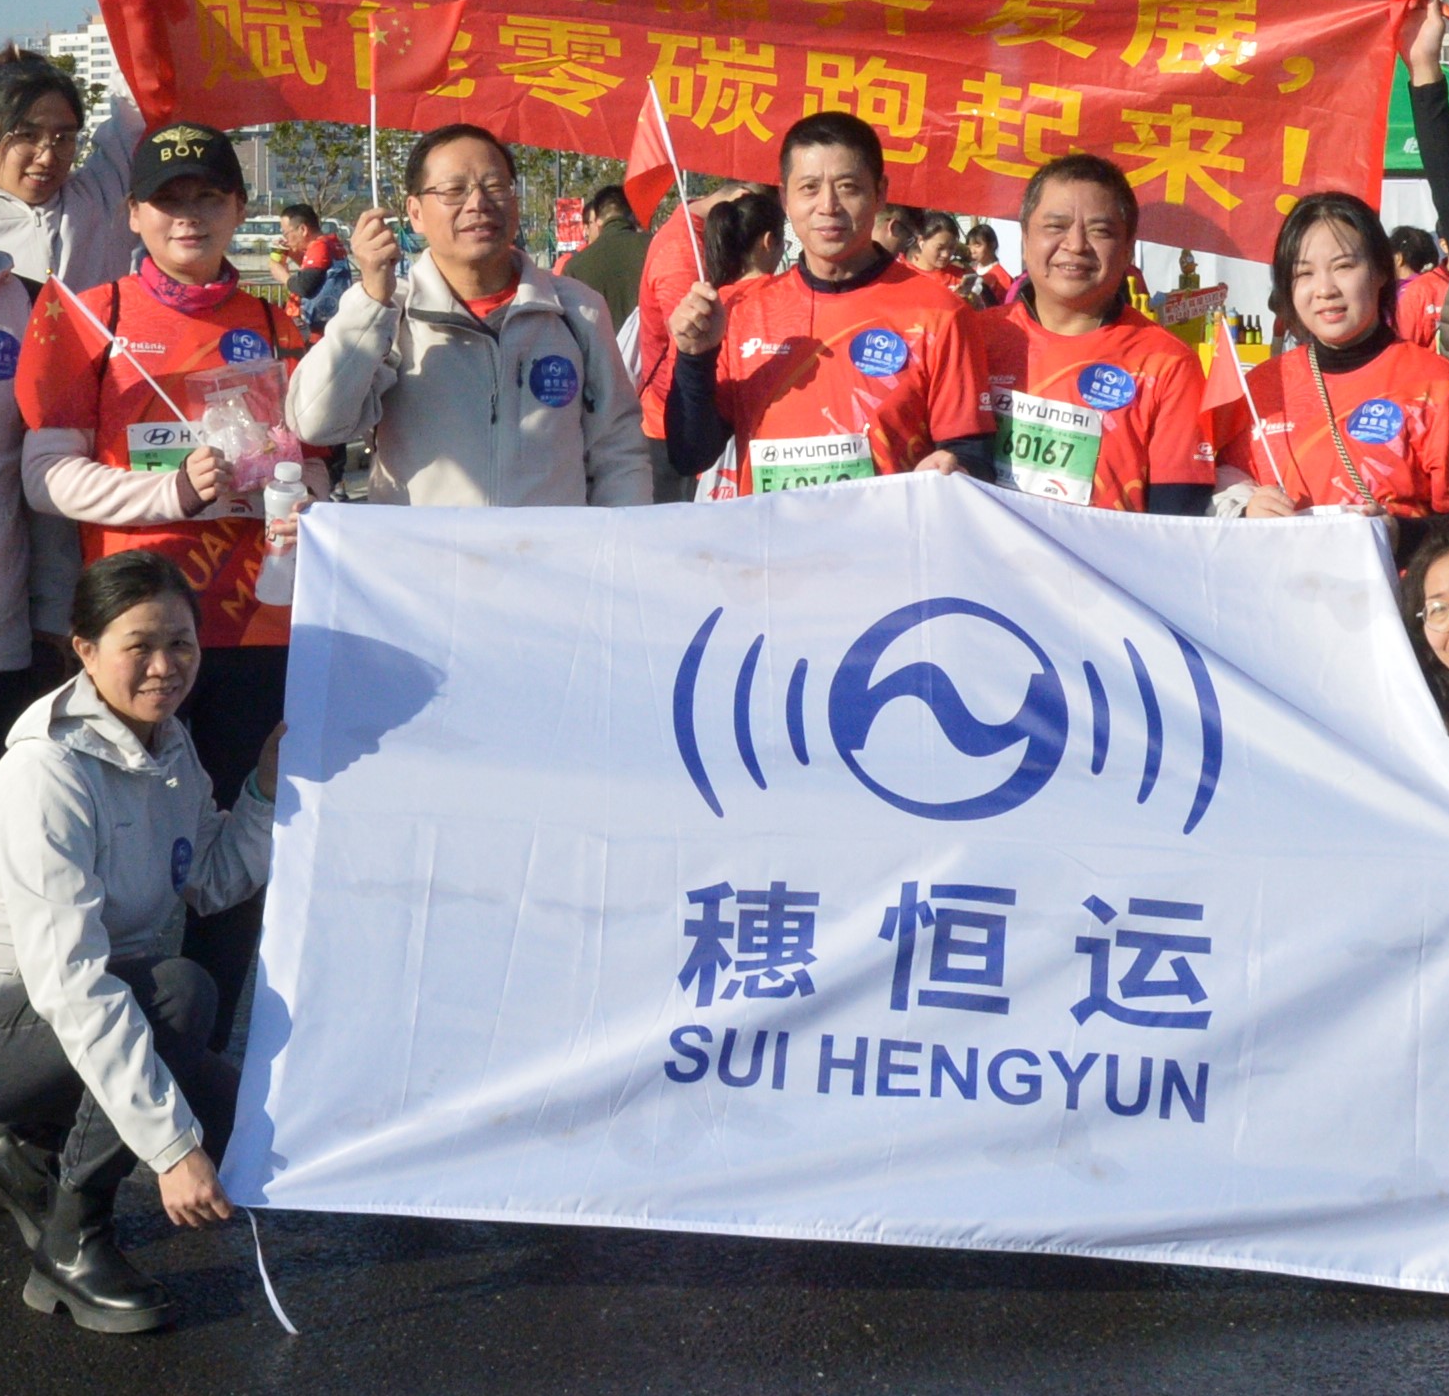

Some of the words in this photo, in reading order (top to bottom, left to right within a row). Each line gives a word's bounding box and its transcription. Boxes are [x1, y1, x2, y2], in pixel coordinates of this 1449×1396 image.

[160, 145, 204, 161] BOY
[1015, 401, 1090, 428] HYUNDAI
[783, 441, 858, 460] HYUNDAI
[678, 881, 1213, 1030] 穗恒运
[664, 1025, 790, 1091] SUI
[817, 1034, 1210, 1123] HENGYUN
